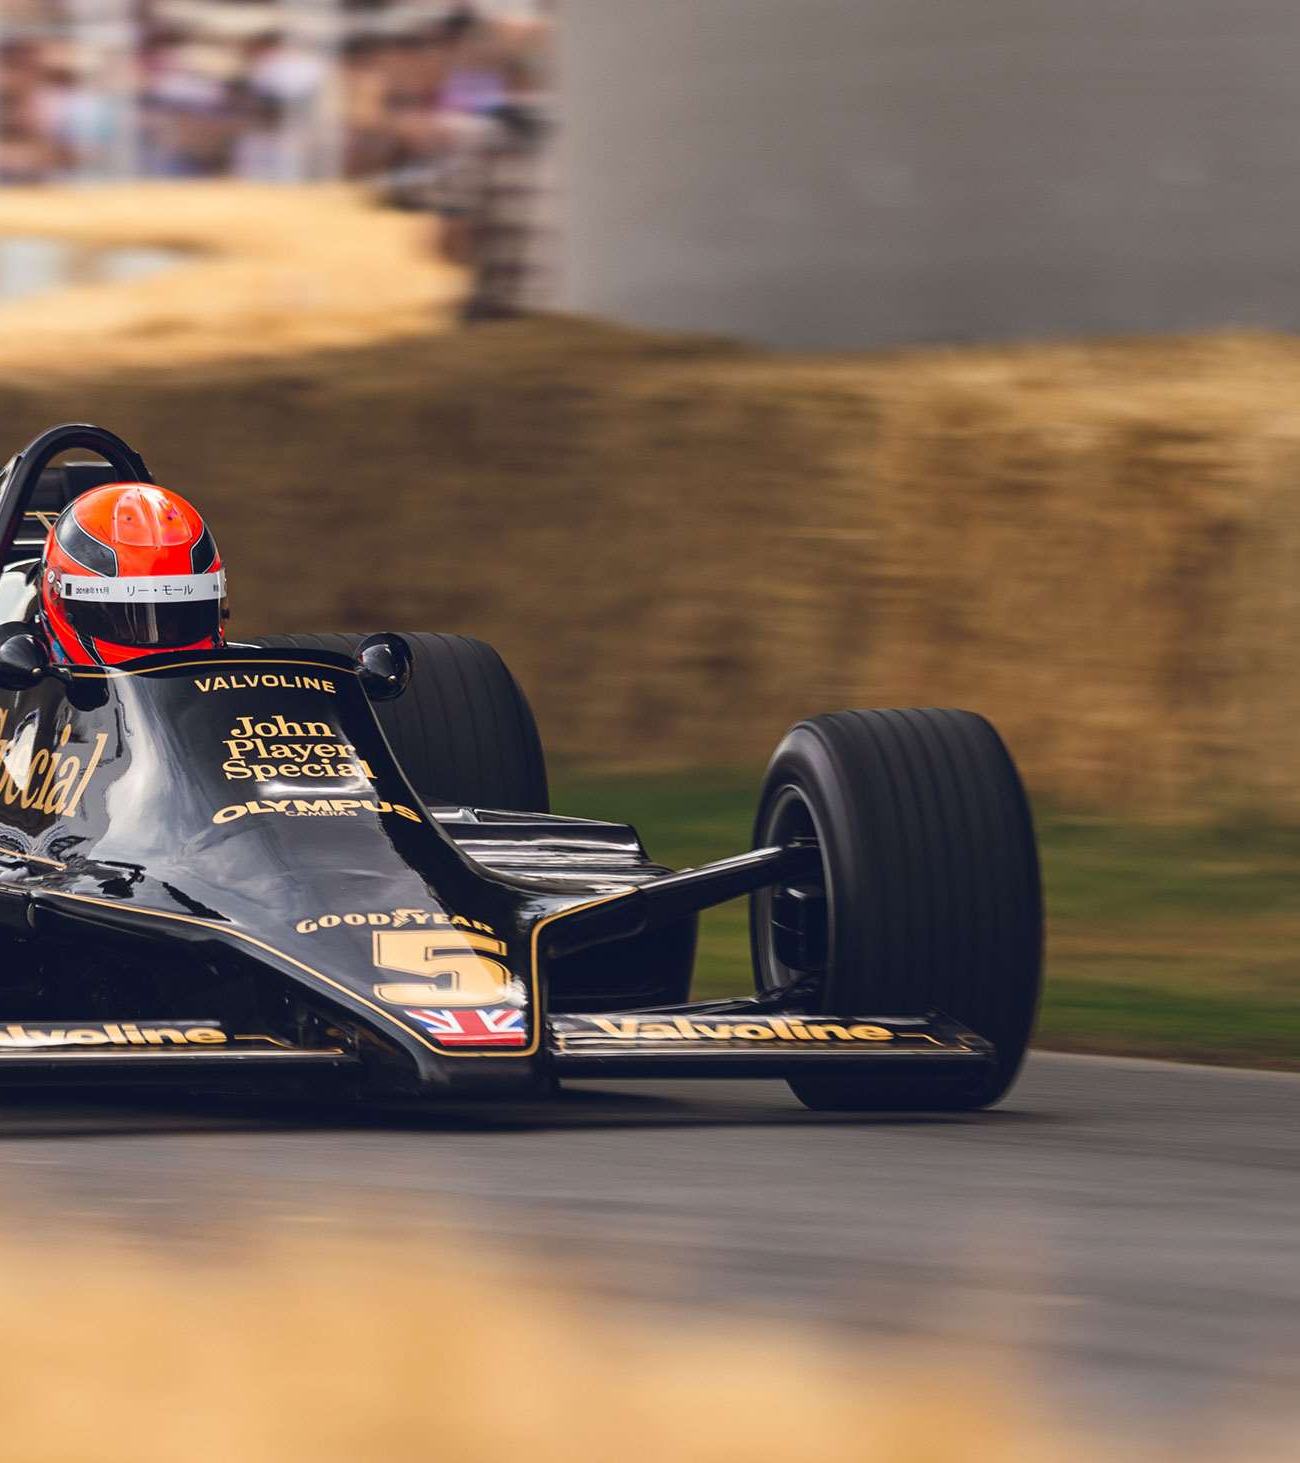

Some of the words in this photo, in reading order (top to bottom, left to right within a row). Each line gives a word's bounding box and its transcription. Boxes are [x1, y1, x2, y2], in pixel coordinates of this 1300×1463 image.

[194, 674, 337, 694] VALVOLINE
[230, 715, 336, 738] John
[222, 738, 357, 762] Player
[221, 758, 378, 782] Special
[212, 799, 423, 825] OLYMPUS
[285, 809, 358, 817] CAMERAS
[295, 908, 496, 936] GOODYEAR
[372, 929, 515, 1007] 5
[590, 1016, 897, 1042] Valvoline
